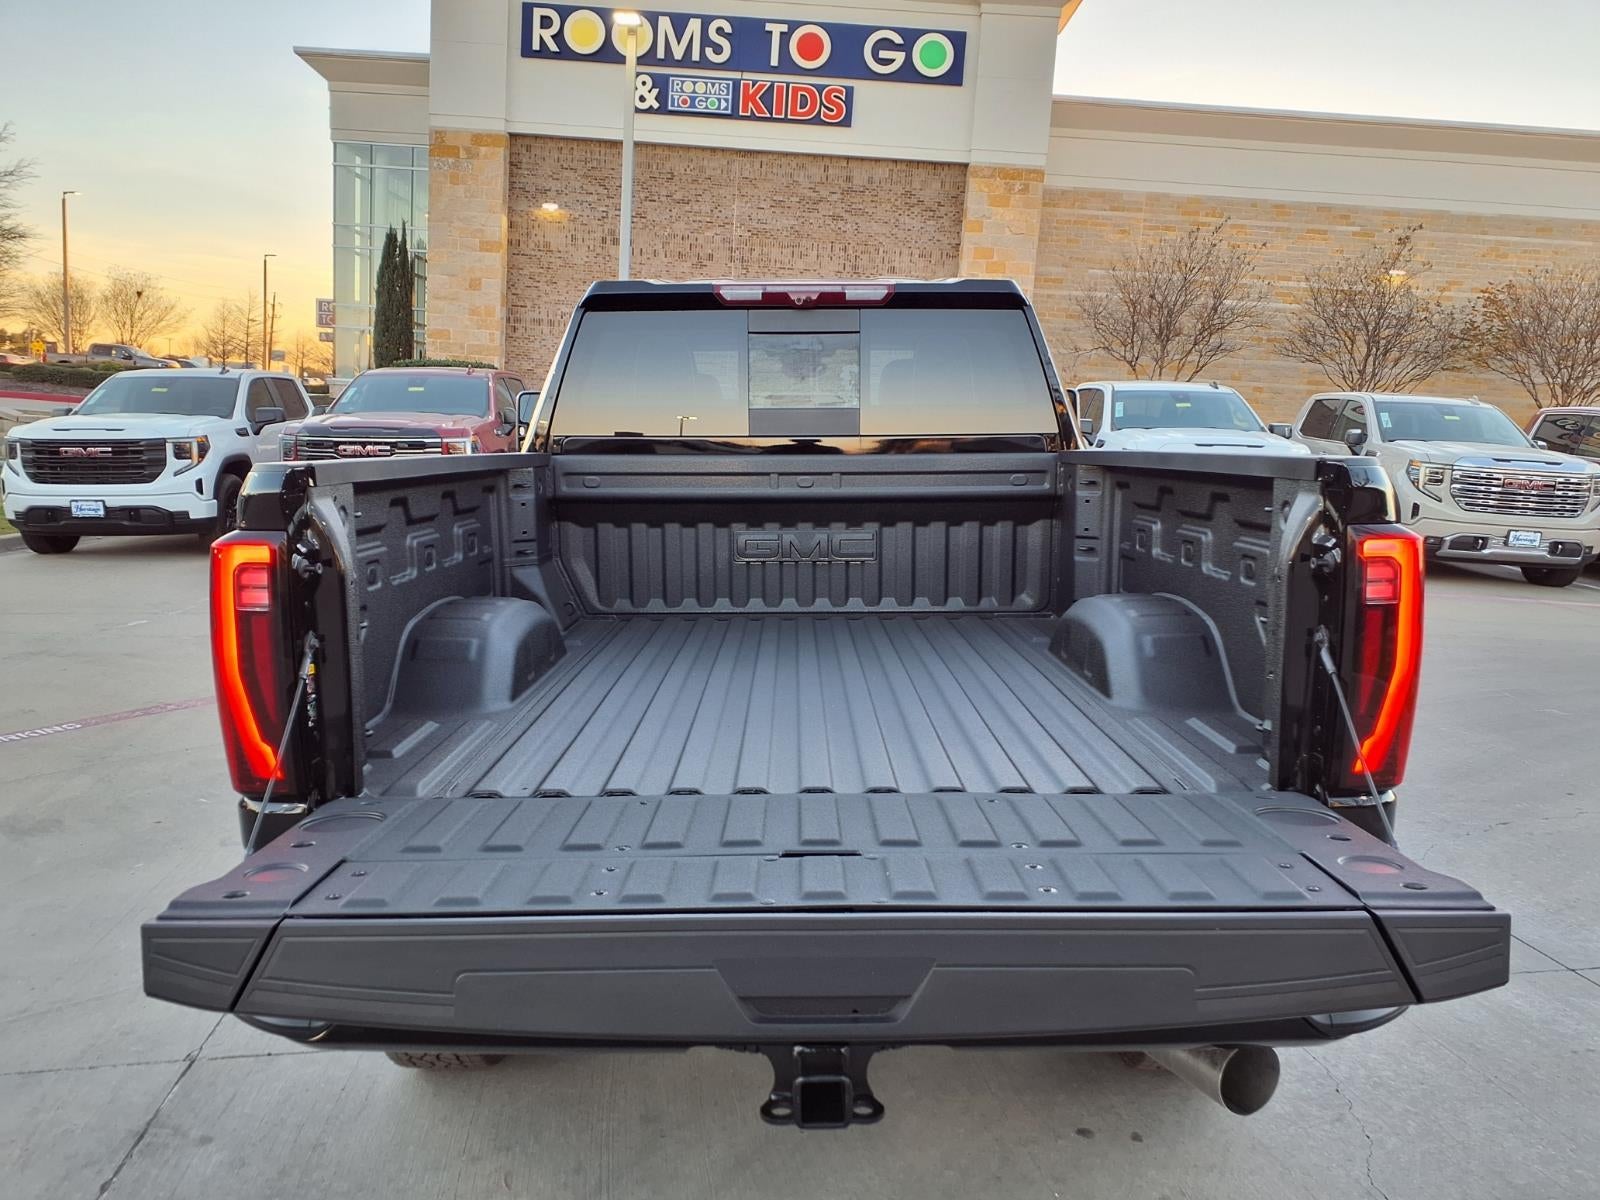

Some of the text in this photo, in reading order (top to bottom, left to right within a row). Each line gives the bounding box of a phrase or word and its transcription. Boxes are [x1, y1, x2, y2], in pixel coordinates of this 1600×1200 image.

[532, 7, 955, 78] ROOMS TO GO
[635, 74, 661, 110] &
[673, 80, 728, 96] ROOMS
[673, 95, 719, 110] TO GO
[739, 80, 847, 123] KIDS
[59, 447, 112, 457] GMC
[338, 445, 391, 456] GMC
[1504, 479, 1556, 491] GMC
[736, 533, 874, 560] GMC
